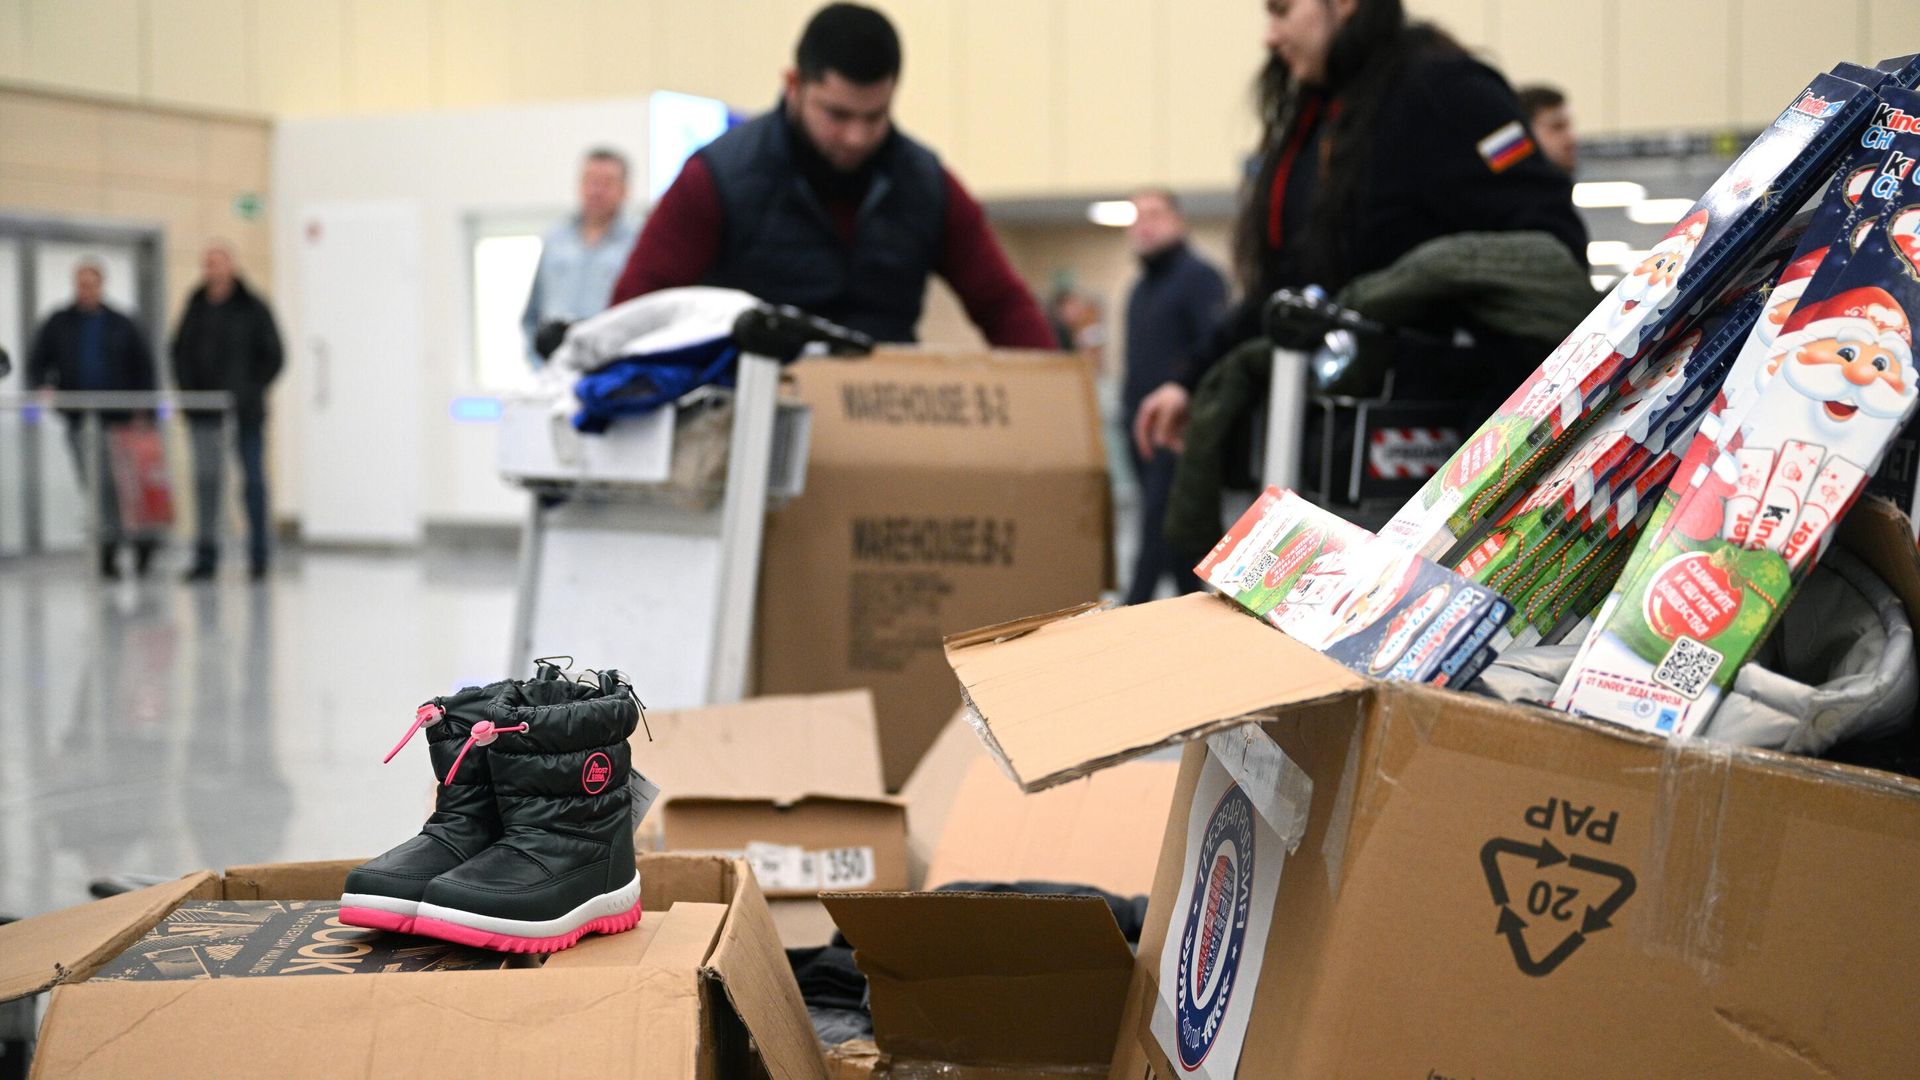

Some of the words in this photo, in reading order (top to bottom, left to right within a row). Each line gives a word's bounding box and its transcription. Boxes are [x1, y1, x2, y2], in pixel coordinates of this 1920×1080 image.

[1684, 583, 1721, 623] ОЩУТИТЕ
[1686, 561, 1737, 614] СКАНИРУЙТЕ
[1525, 797, 1619, 845] PAP
[828, 850, 866, 880] 350
[1199, 799, 1241, 884] ТРЕЗВАЯ
[1236, 804, 1251, 929] РОССИЯ
[1527, 880, 1579, 921] 20
